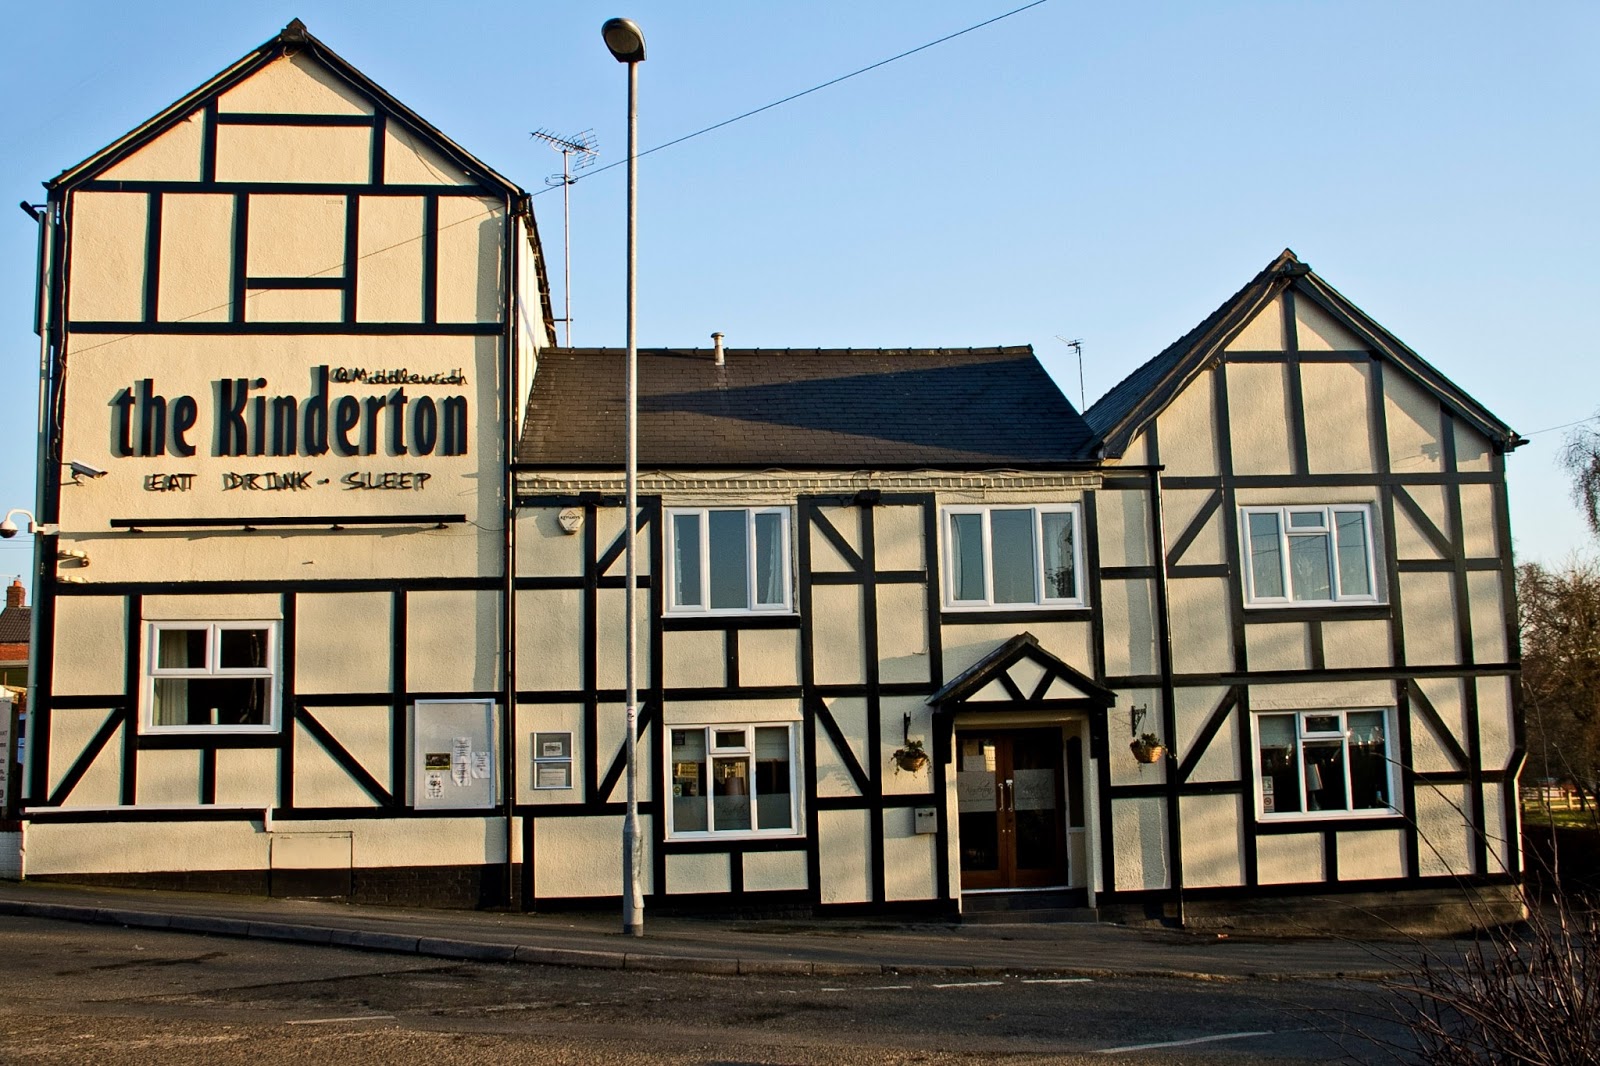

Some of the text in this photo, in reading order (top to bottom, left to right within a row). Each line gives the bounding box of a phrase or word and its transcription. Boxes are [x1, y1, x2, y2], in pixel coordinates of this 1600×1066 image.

[114, 364, 468, 457] the Kinderton
[151, 471, 432, 491] EAT DRINK SLEEP
